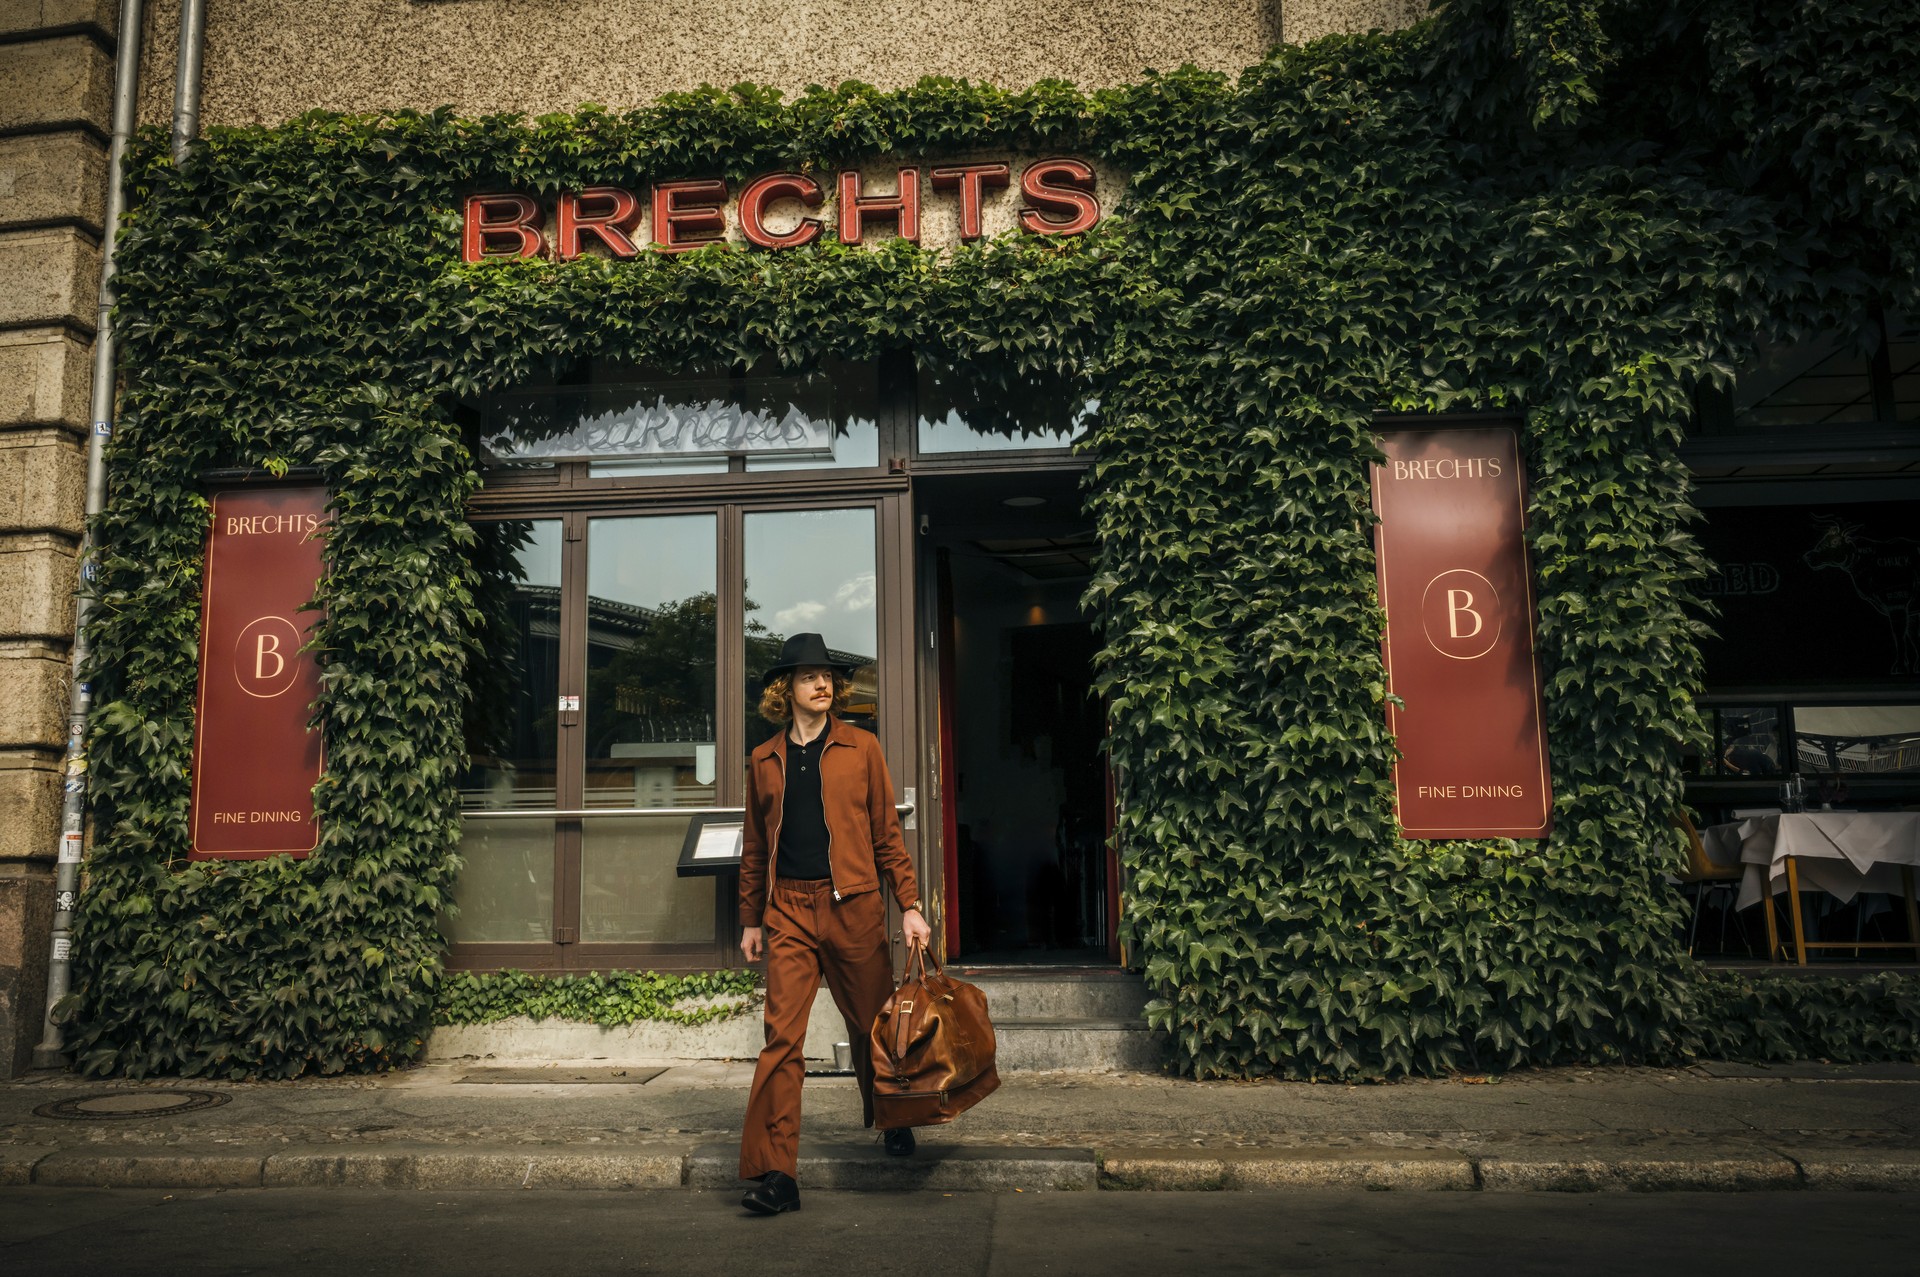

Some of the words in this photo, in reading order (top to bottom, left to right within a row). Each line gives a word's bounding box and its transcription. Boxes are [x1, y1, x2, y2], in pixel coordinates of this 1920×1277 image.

[462, 158, 1101, 263] BRECHTS
[1394, 457, 1502, 481] BRECHTS
[227, 514, 318, 535] BRECHTS
[1688, 563, 1780, 595] GED
[1447, 589, 1483, 639] B
[255, 633, 285, 679] B
[1418, 786, 1457, 798] FINE
[1462, 784, 1523, 798] DINING
[213, 812, 246, 824] FINE
[250, 810, 301, 823] DINING
